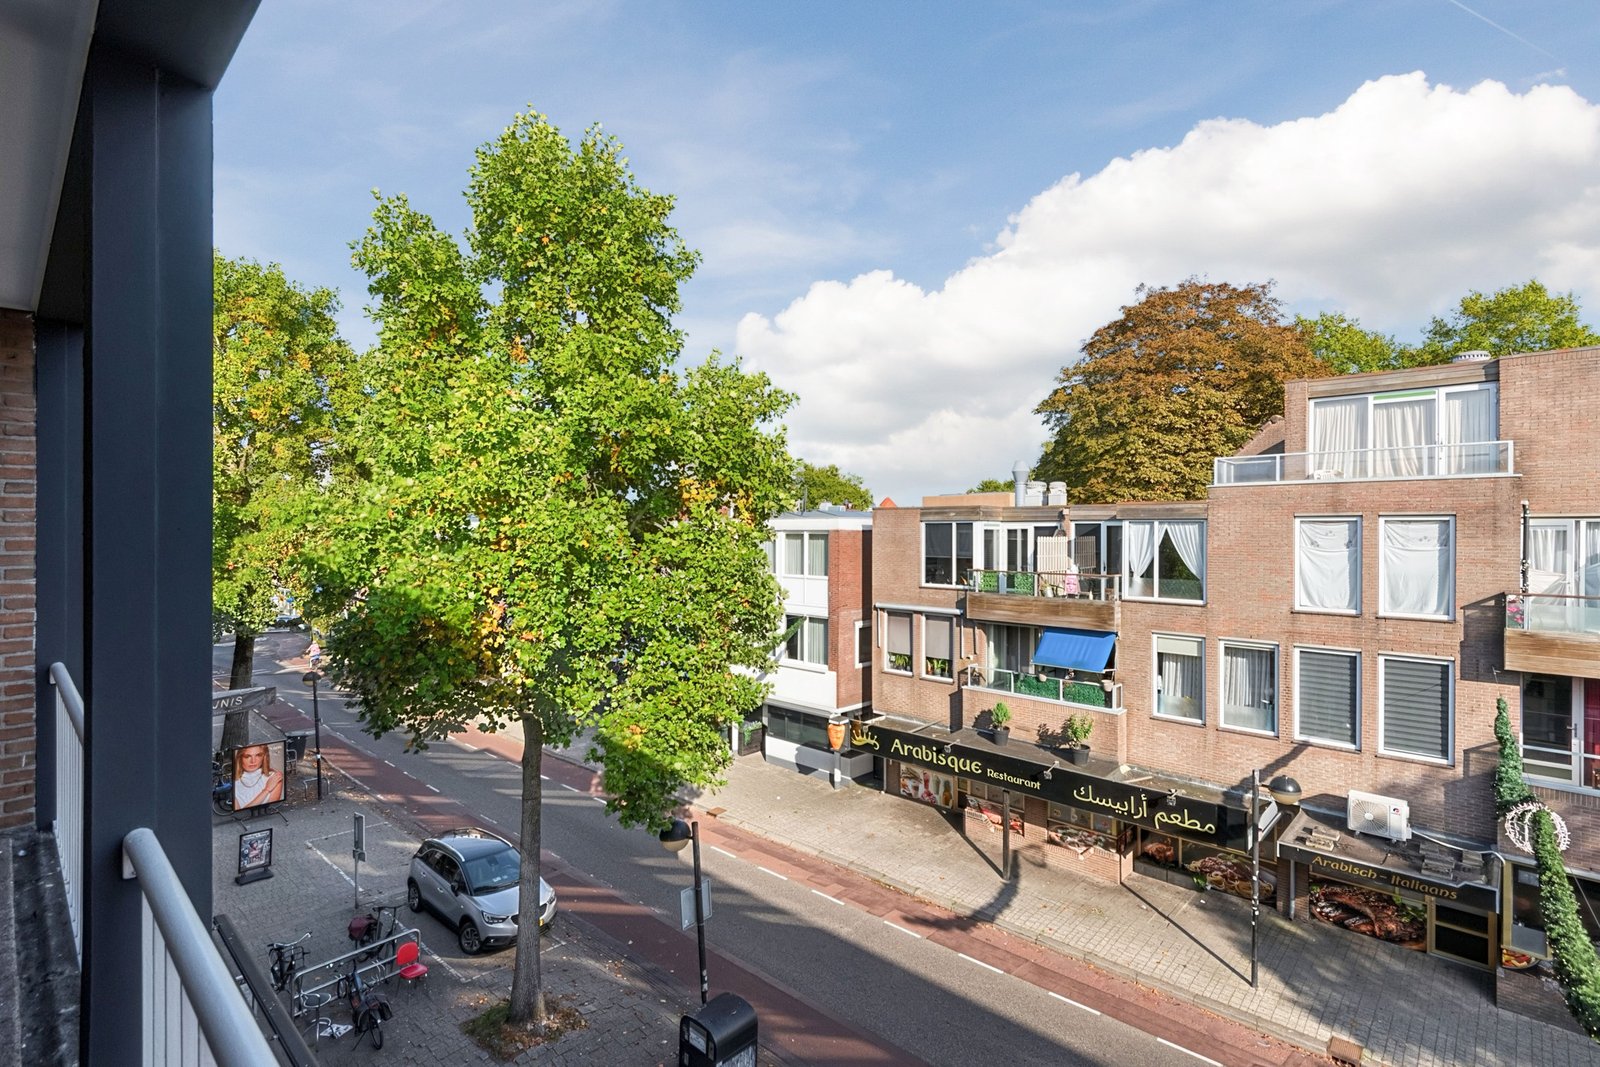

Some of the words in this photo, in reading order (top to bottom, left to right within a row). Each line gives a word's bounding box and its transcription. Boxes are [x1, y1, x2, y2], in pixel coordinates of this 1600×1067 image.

[891, 738, 983, 775] Arabisque
[987, 769, 1041, 791] Restaurant
[1074, 785, 1148, 819] أرابيسك
[1154, 809, 1216, 835] مطعم
[1312, 856, 1377, 880] Arabisch
[1392, 876, 1457, 899] Italiaans
